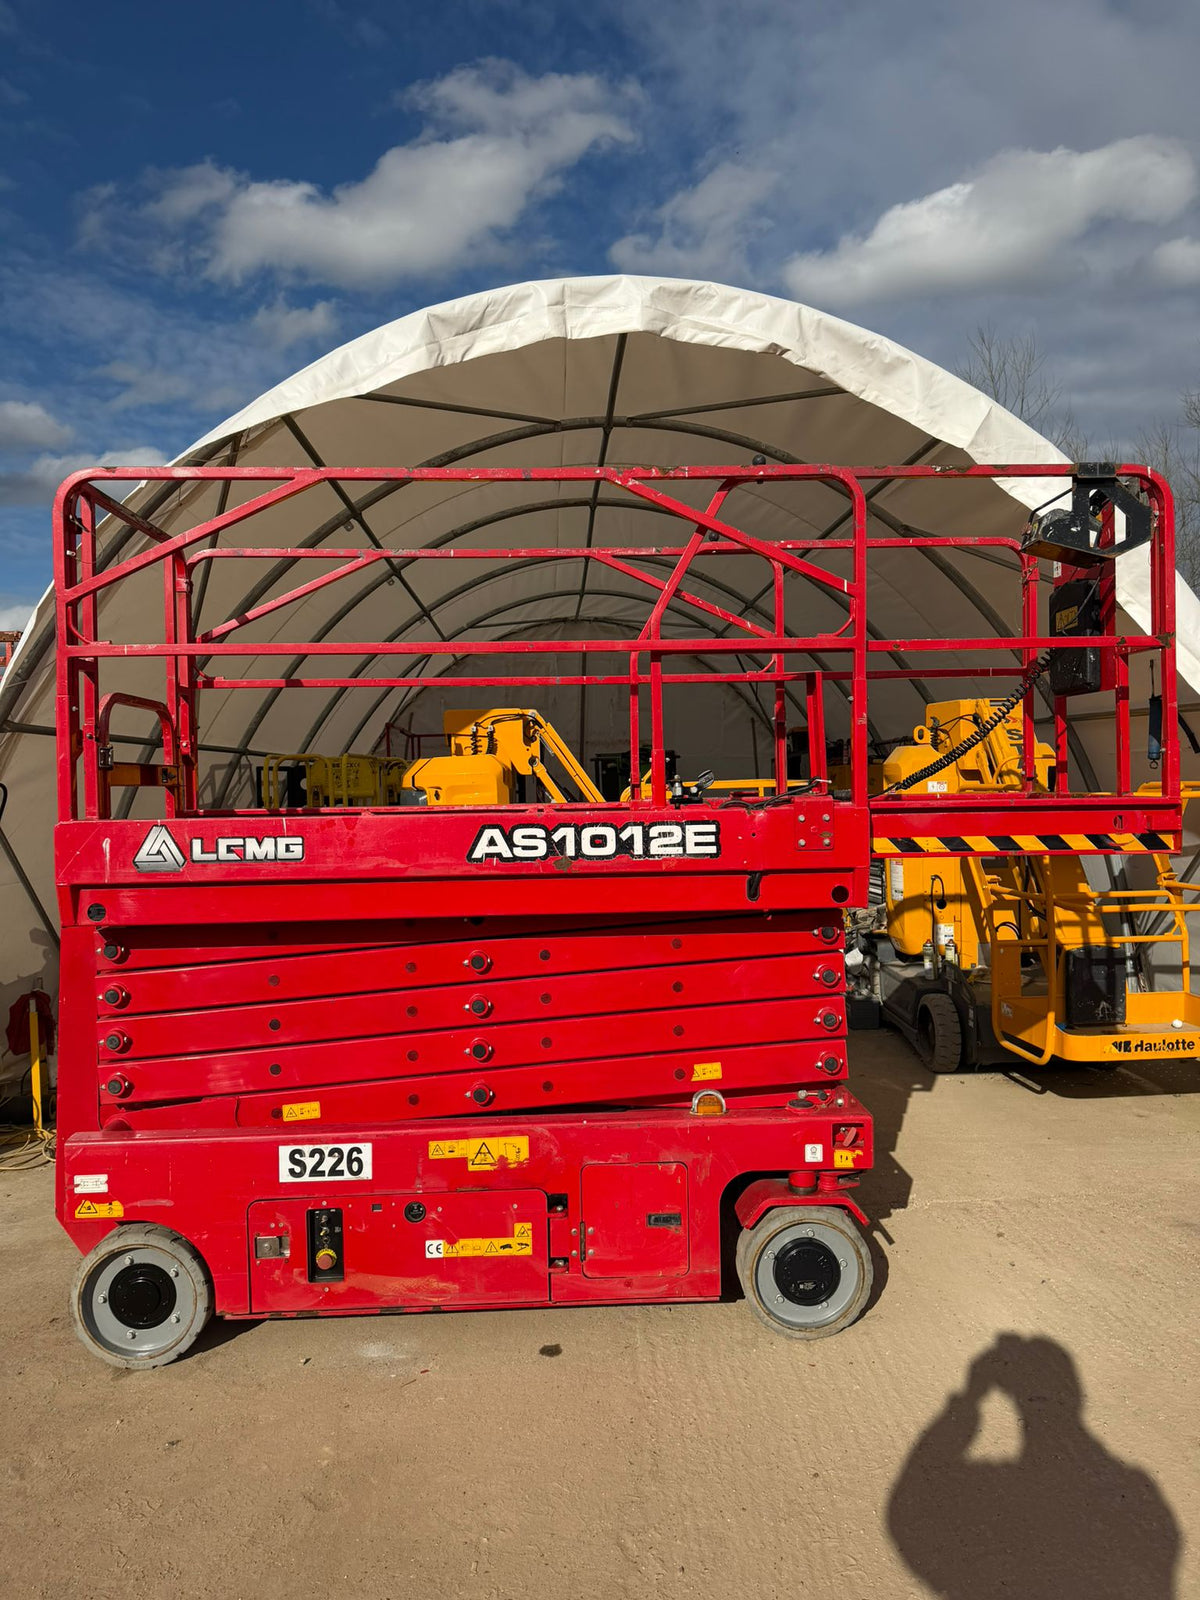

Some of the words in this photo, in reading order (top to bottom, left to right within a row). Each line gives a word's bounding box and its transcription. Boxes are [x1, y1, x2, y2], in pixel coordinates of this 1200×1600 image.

[191, 836, 304, 862] LCMG
[470, 824, 719, 860] AS1012E
[288, 1146, 364, 1179] S226
